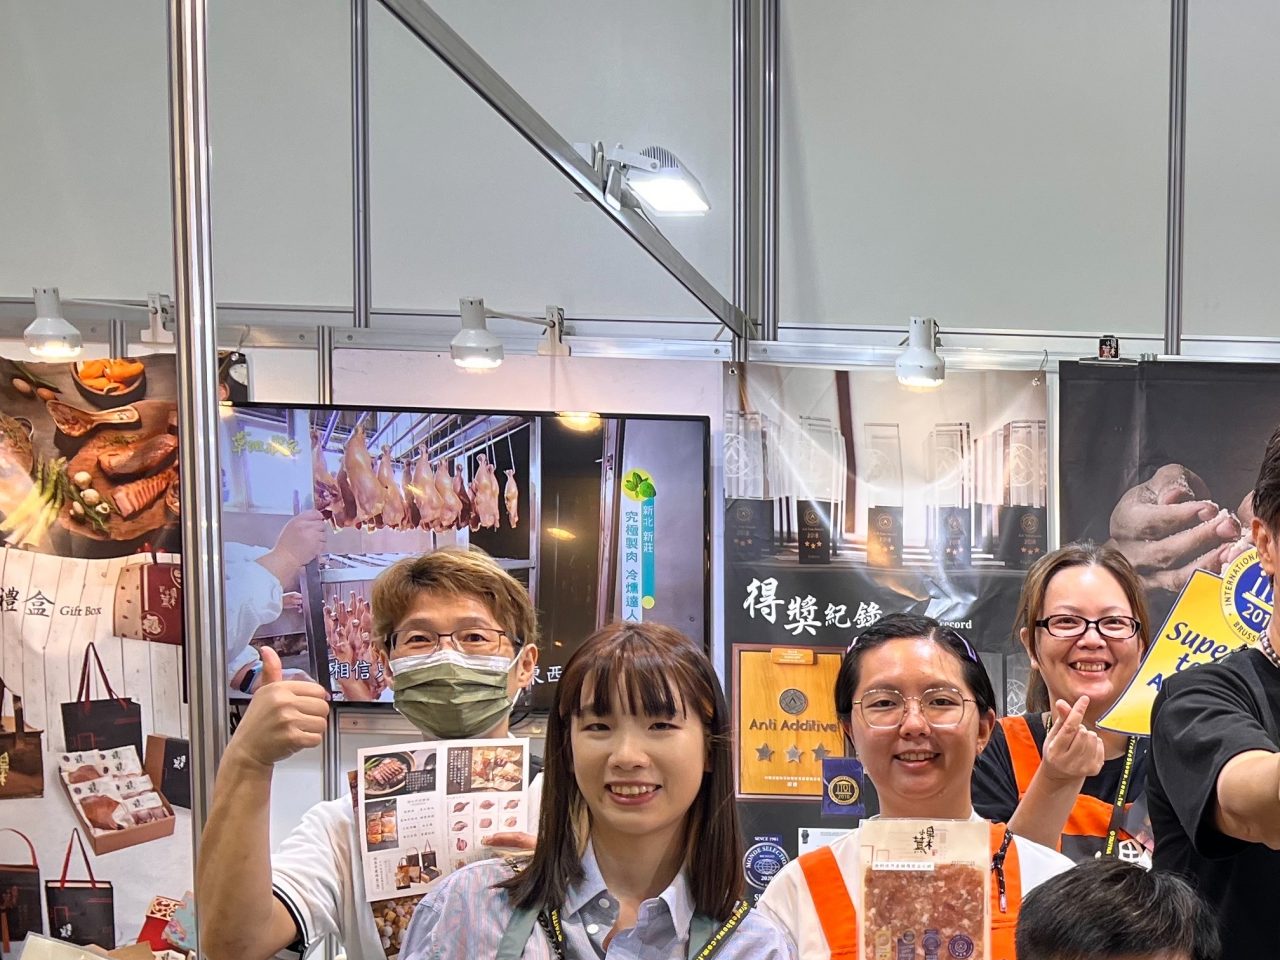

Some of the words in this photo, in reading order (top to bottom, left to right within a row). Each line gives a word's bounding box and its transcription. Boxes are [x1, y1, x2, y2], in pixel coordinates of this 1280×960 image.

[643, 505, 654, 527] 新北
[60, 605, 82, 616] Gift
[85, 606, 102, 616] Box
[743, 577, 883, 636] 得獎紀錄
[1242, 603, 1270, 628] 201
[1166, 622, 1228, 660] Supe
[1233, 620, 1257, 643] BRUSS
[749, 718, 777, 731] Anti
[745, 846, 763, 869] MONDE
[761, 845, 787, 864] SELECTIO
